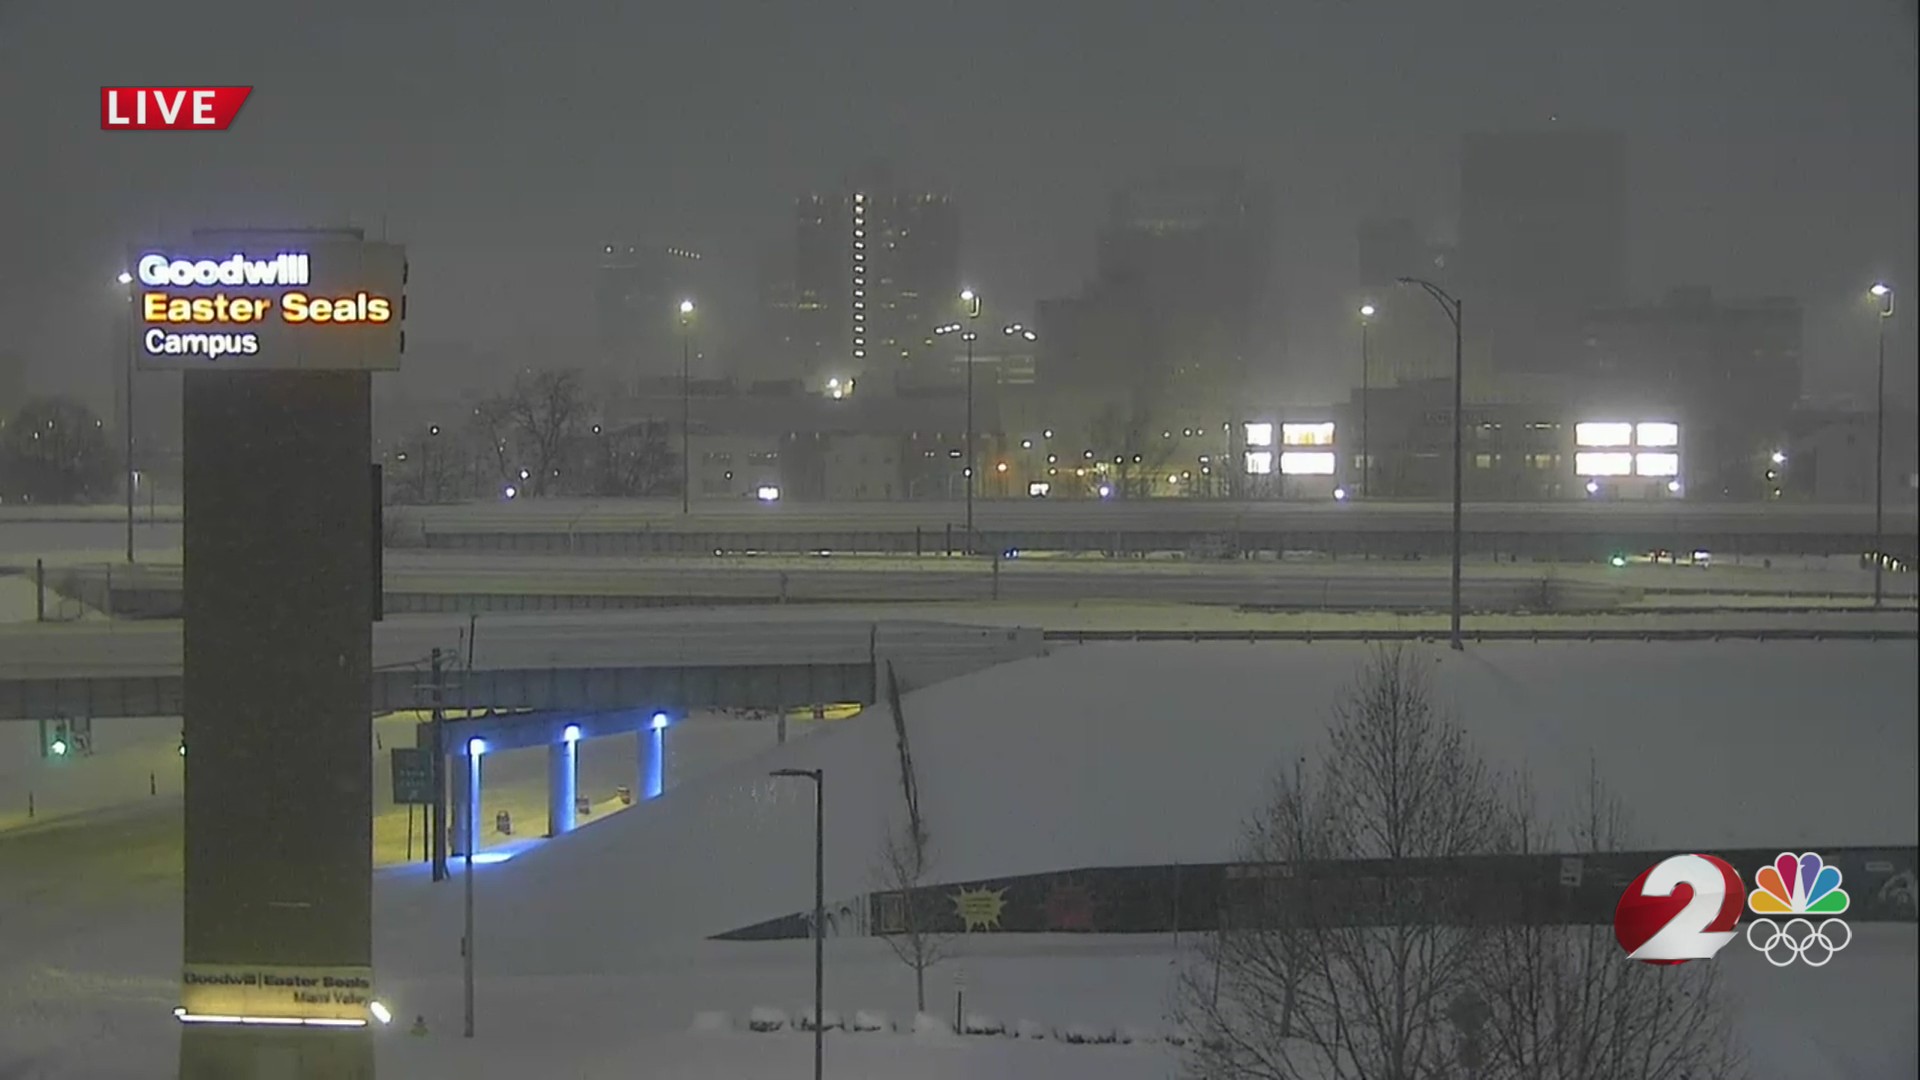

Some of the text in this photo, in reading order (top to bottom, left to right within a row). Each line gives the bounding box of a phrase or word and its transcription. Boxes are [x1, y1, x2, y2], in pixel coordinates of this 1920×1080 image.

[139, 254, 309, 285] Goodwill
[144, 293, 391, 322] Easter Seals
[145, 329, 258, 359] Campus
